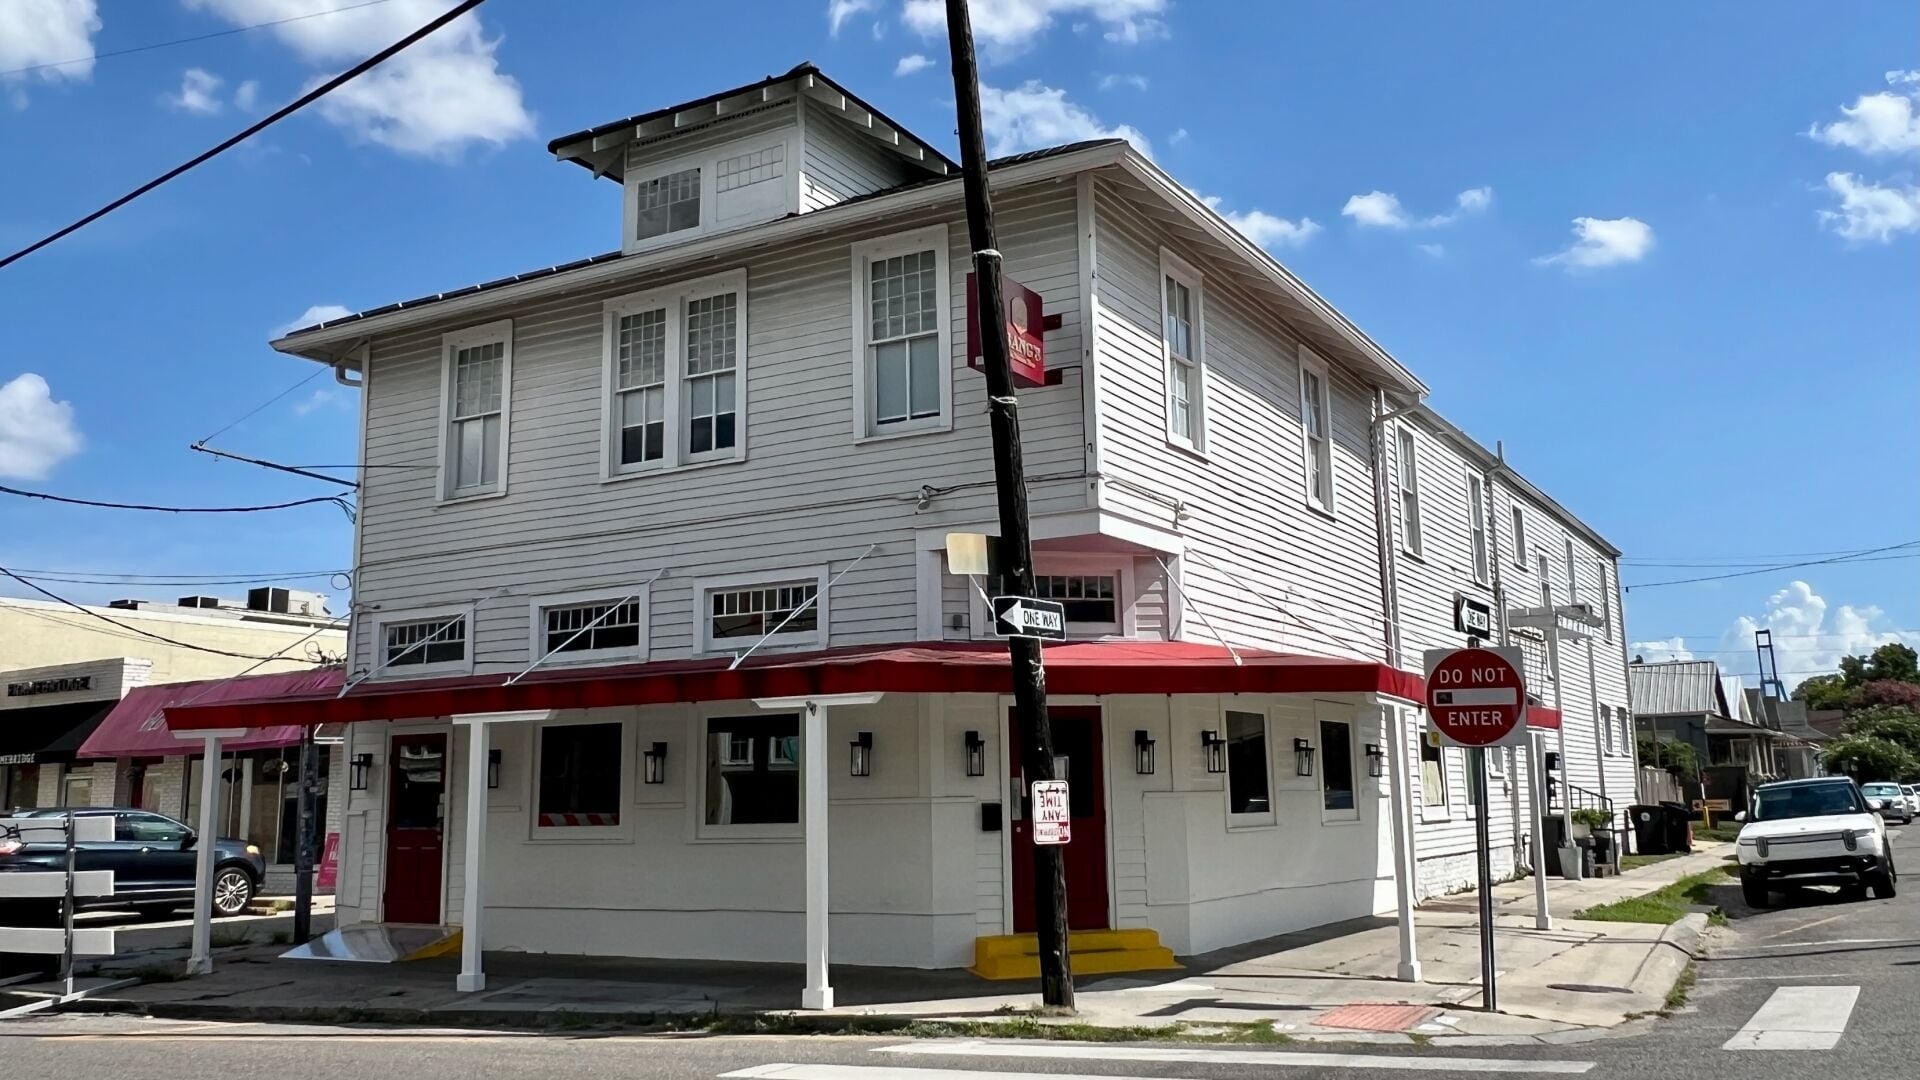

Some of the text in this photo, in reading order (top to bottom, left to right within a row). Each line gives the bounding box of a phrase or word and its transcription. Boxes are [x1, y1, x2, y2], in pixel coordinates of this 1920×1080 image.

[1008, 333, 1041, 361] ANG'S
[1024, 610, 1058, 627] ONE WAY
[1439, 667, 1506, 684] DO NOT
[1448, 711, 1503, 726] ENTER
[1040, 795, 1062, 808] TIME
[1042, 810, 1061, 821] ANY
